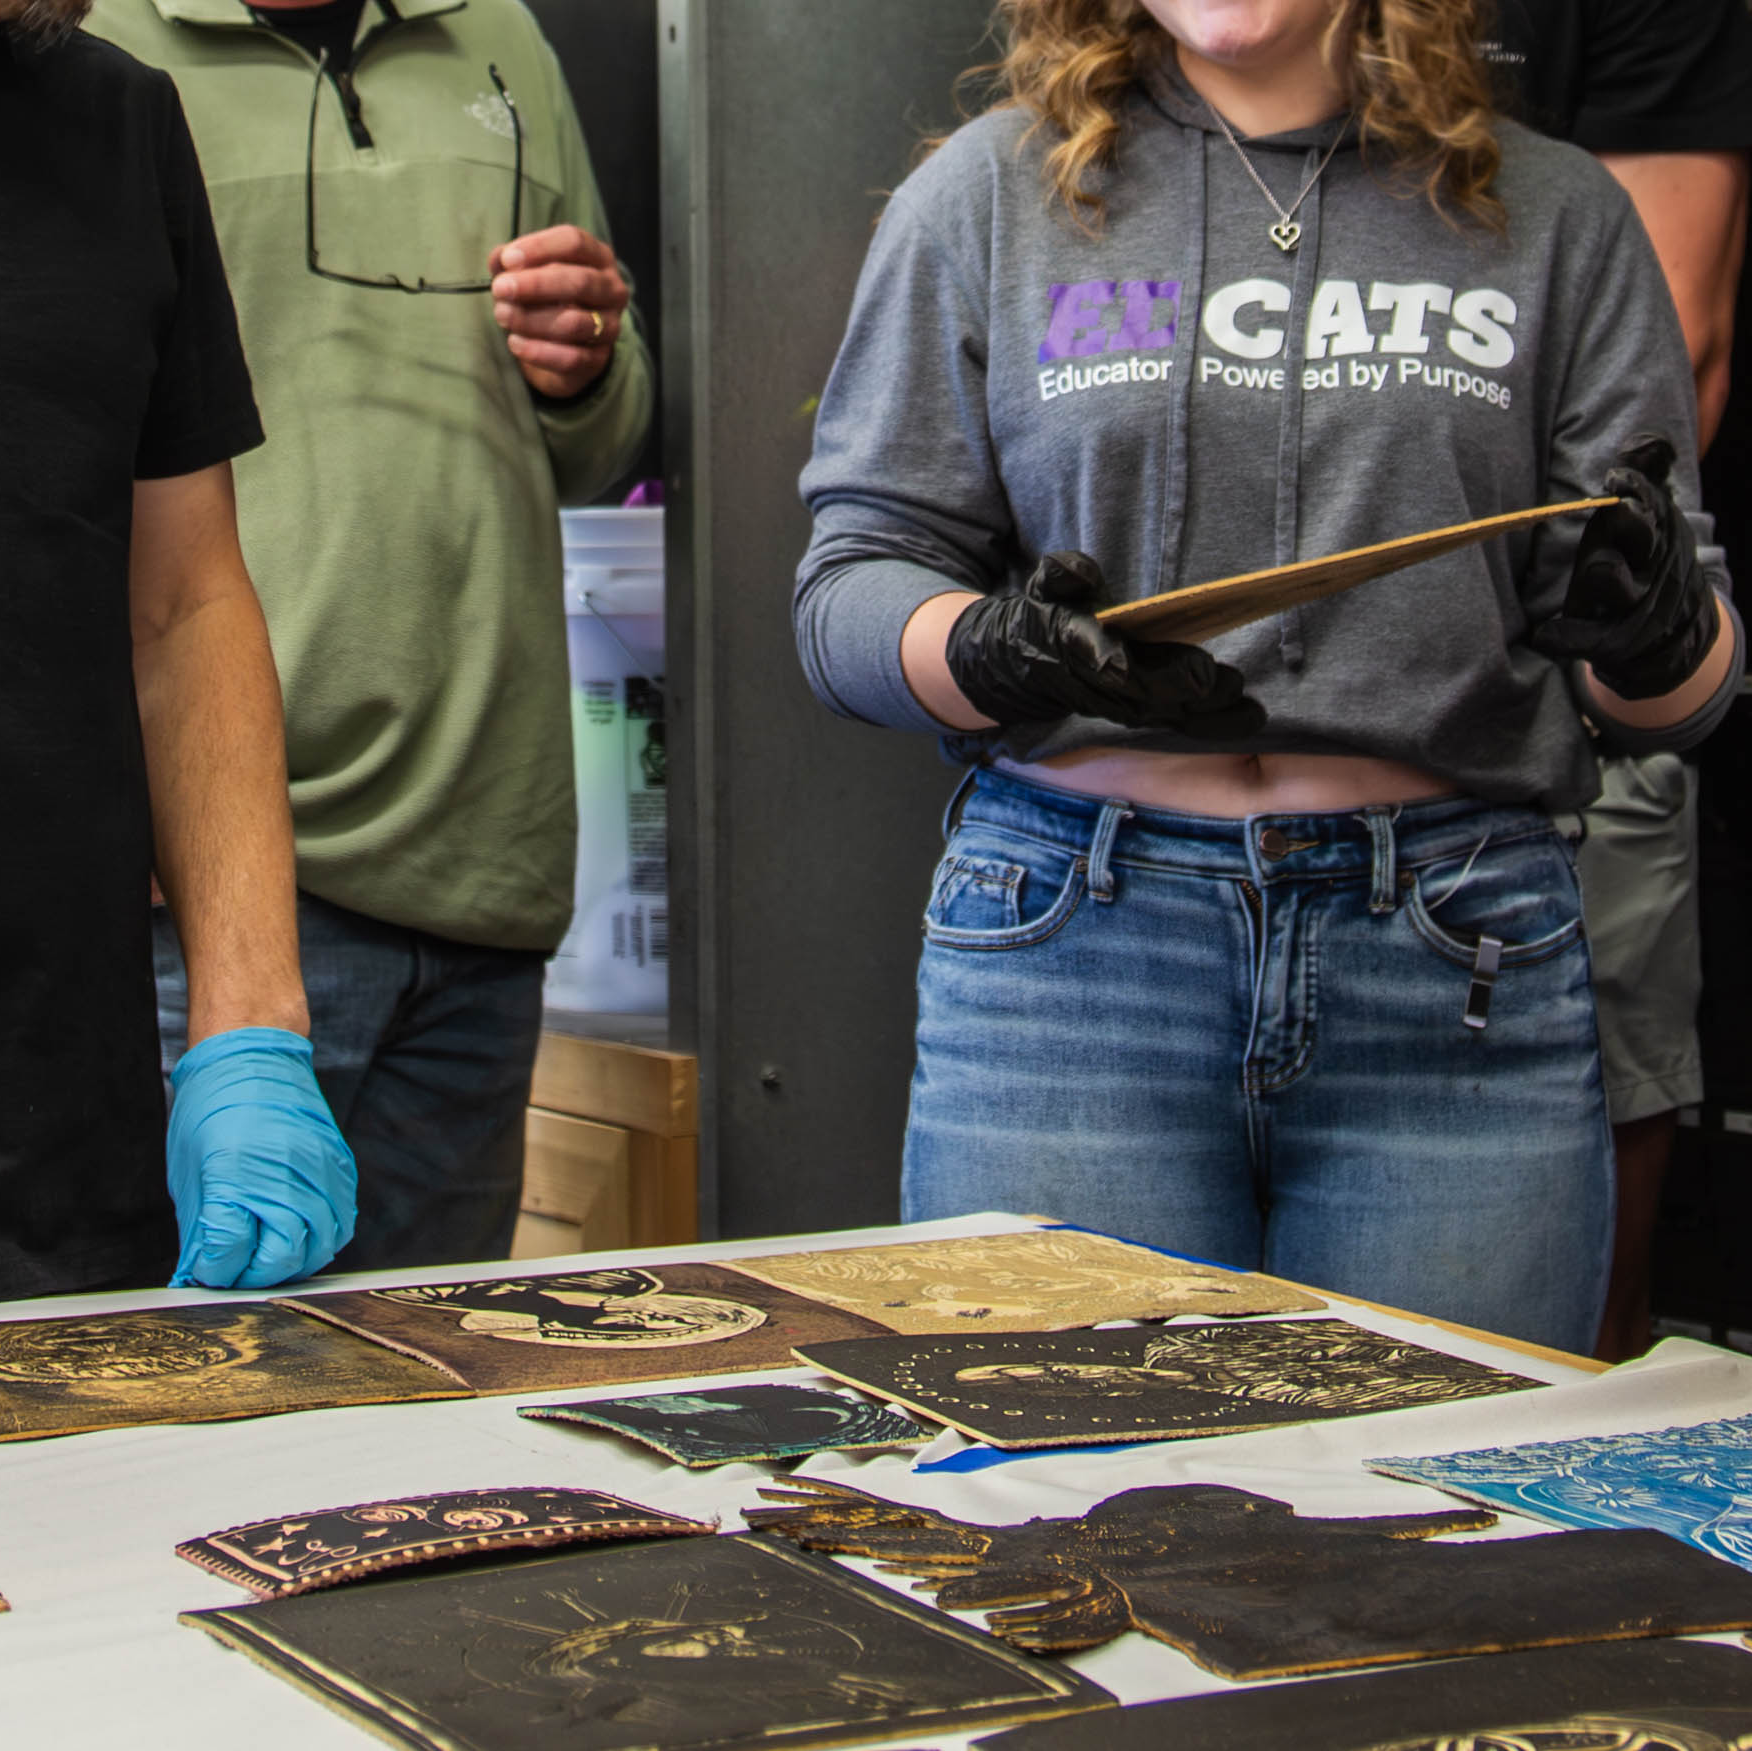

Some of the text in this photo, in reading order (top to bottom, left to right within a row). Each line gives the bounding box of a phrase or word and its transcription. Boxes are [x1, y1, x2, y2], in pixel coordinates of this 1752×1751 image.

[1204, 278, 1518, 368] CATS
[1200, 356, 1340, 390] Poweed
[1350, 359, 1390, 392] by
[1399, 358, 1513, 410] Purpose
